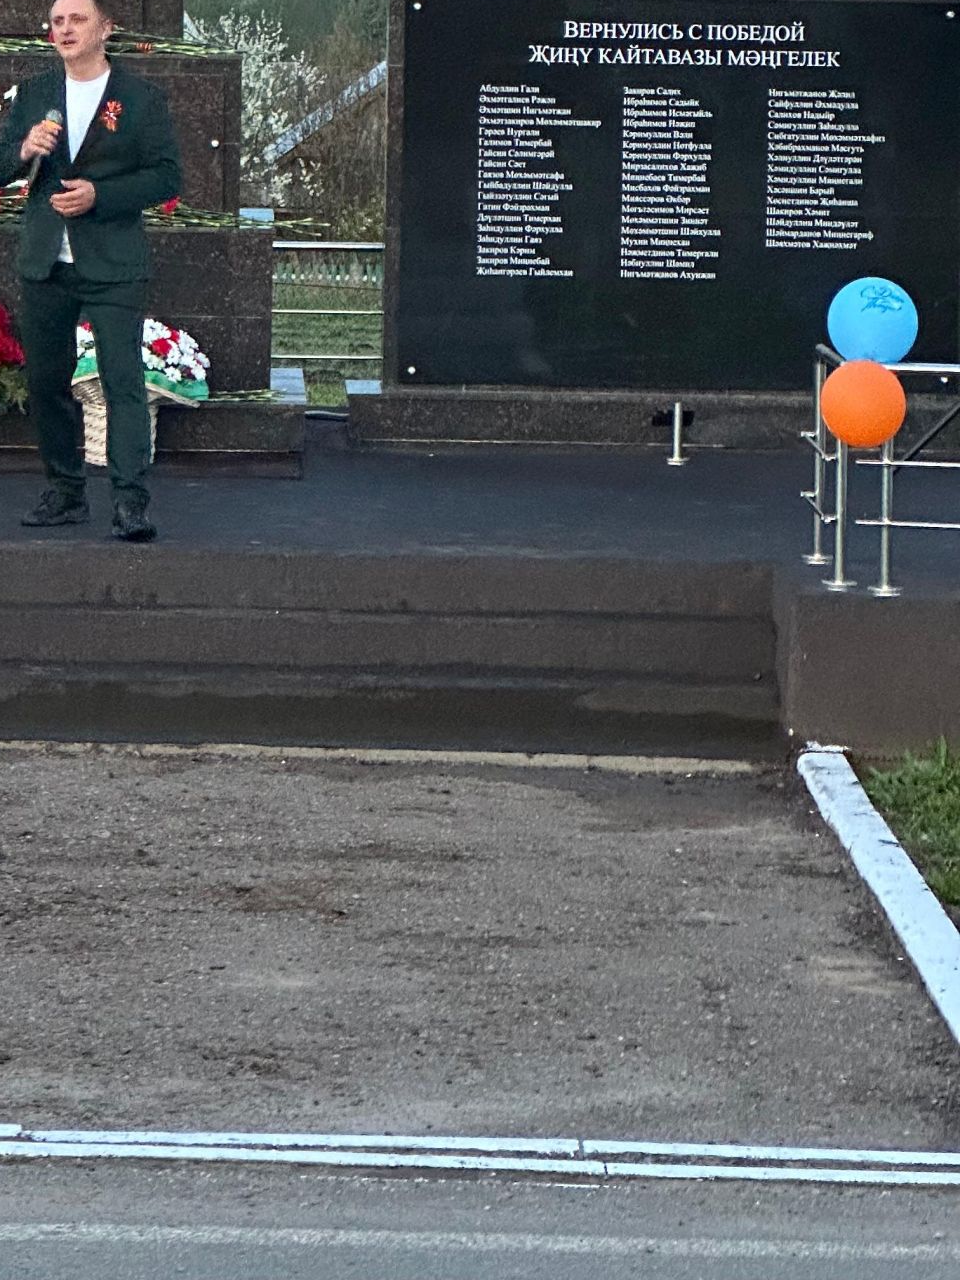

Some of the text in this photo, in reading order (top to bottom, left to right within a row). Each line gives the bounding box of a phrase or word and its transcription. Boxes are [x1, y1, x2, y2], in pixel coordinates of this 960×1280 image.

[563, 21, 805, 43] ВЕРНУЛИСЬ С ПОБЕДОЙ
[598, 45, 722, 67] КАЙТАВАЗЫ
[728, 48, 841, 69] МӘҢГЕЛЕК
